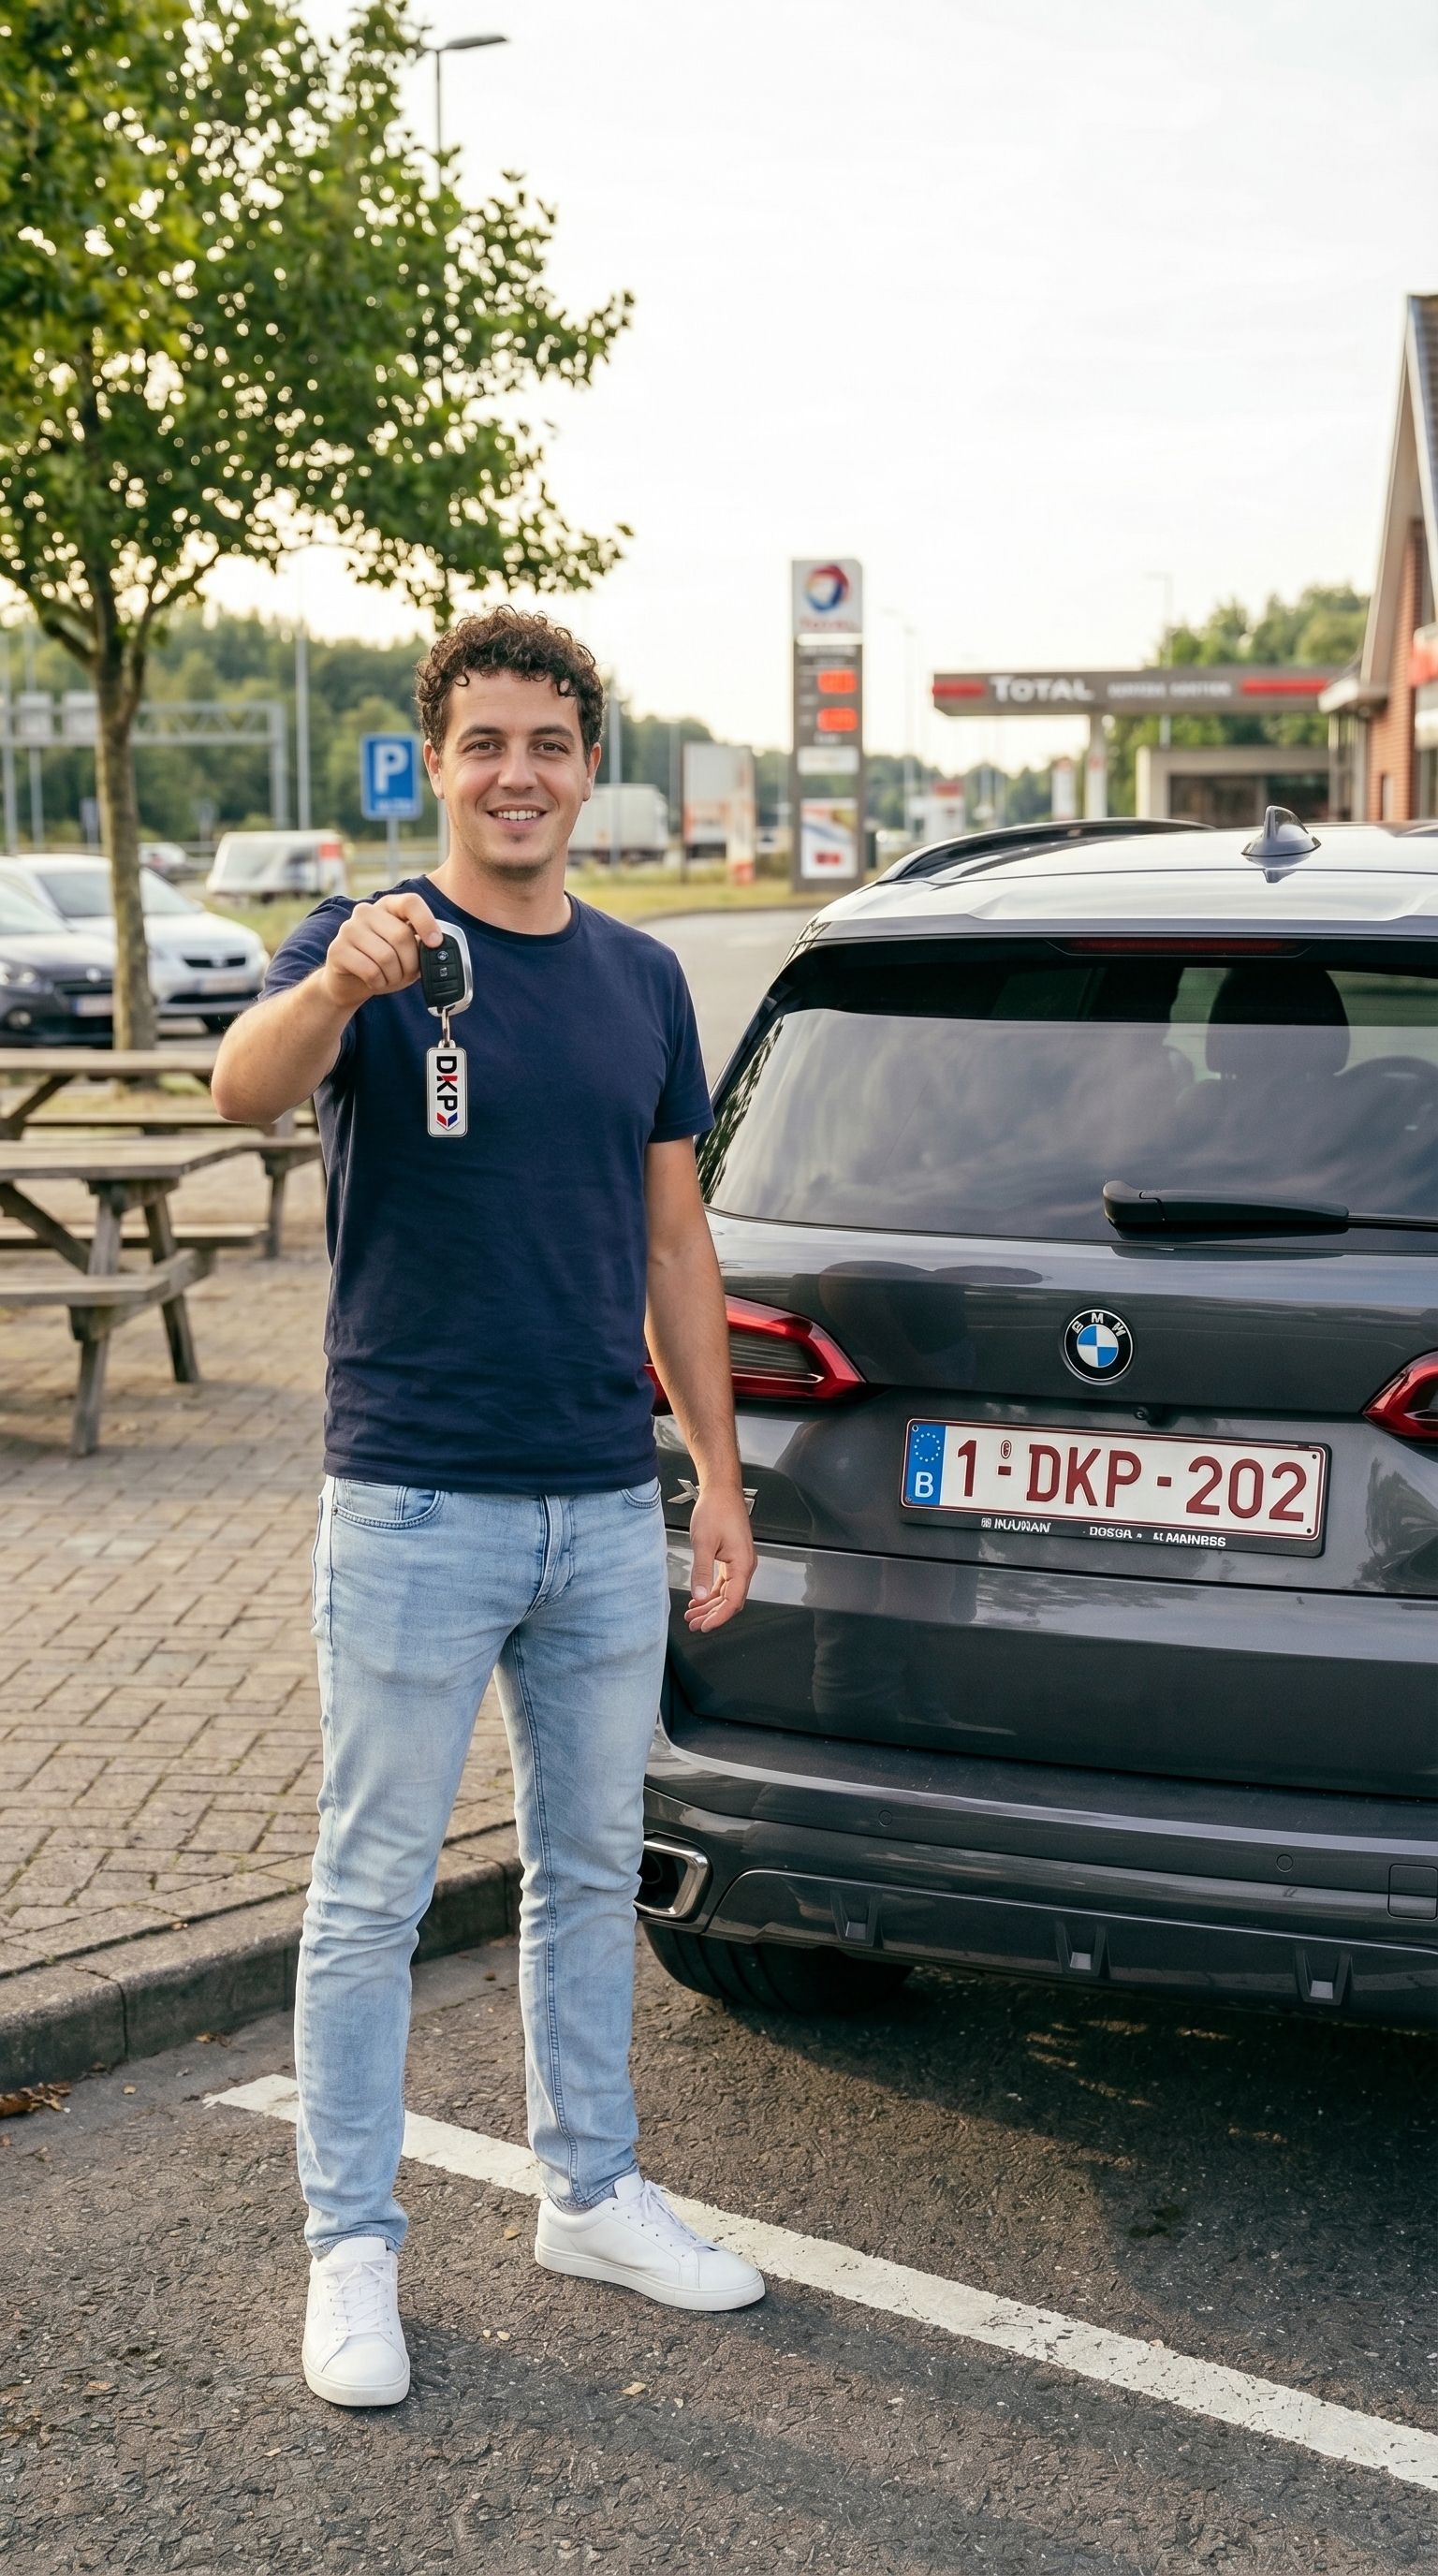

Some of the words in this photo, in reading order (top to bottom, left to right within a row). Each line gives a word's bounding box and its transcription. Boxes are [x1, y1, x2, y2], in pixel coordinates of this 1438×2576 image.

[989, 674, 1094, 702] TOTAL
[374, 742, 409, 795] P
[436, 1055, 459, 1112] DKP
[914, 1471, 934, 1499] B
